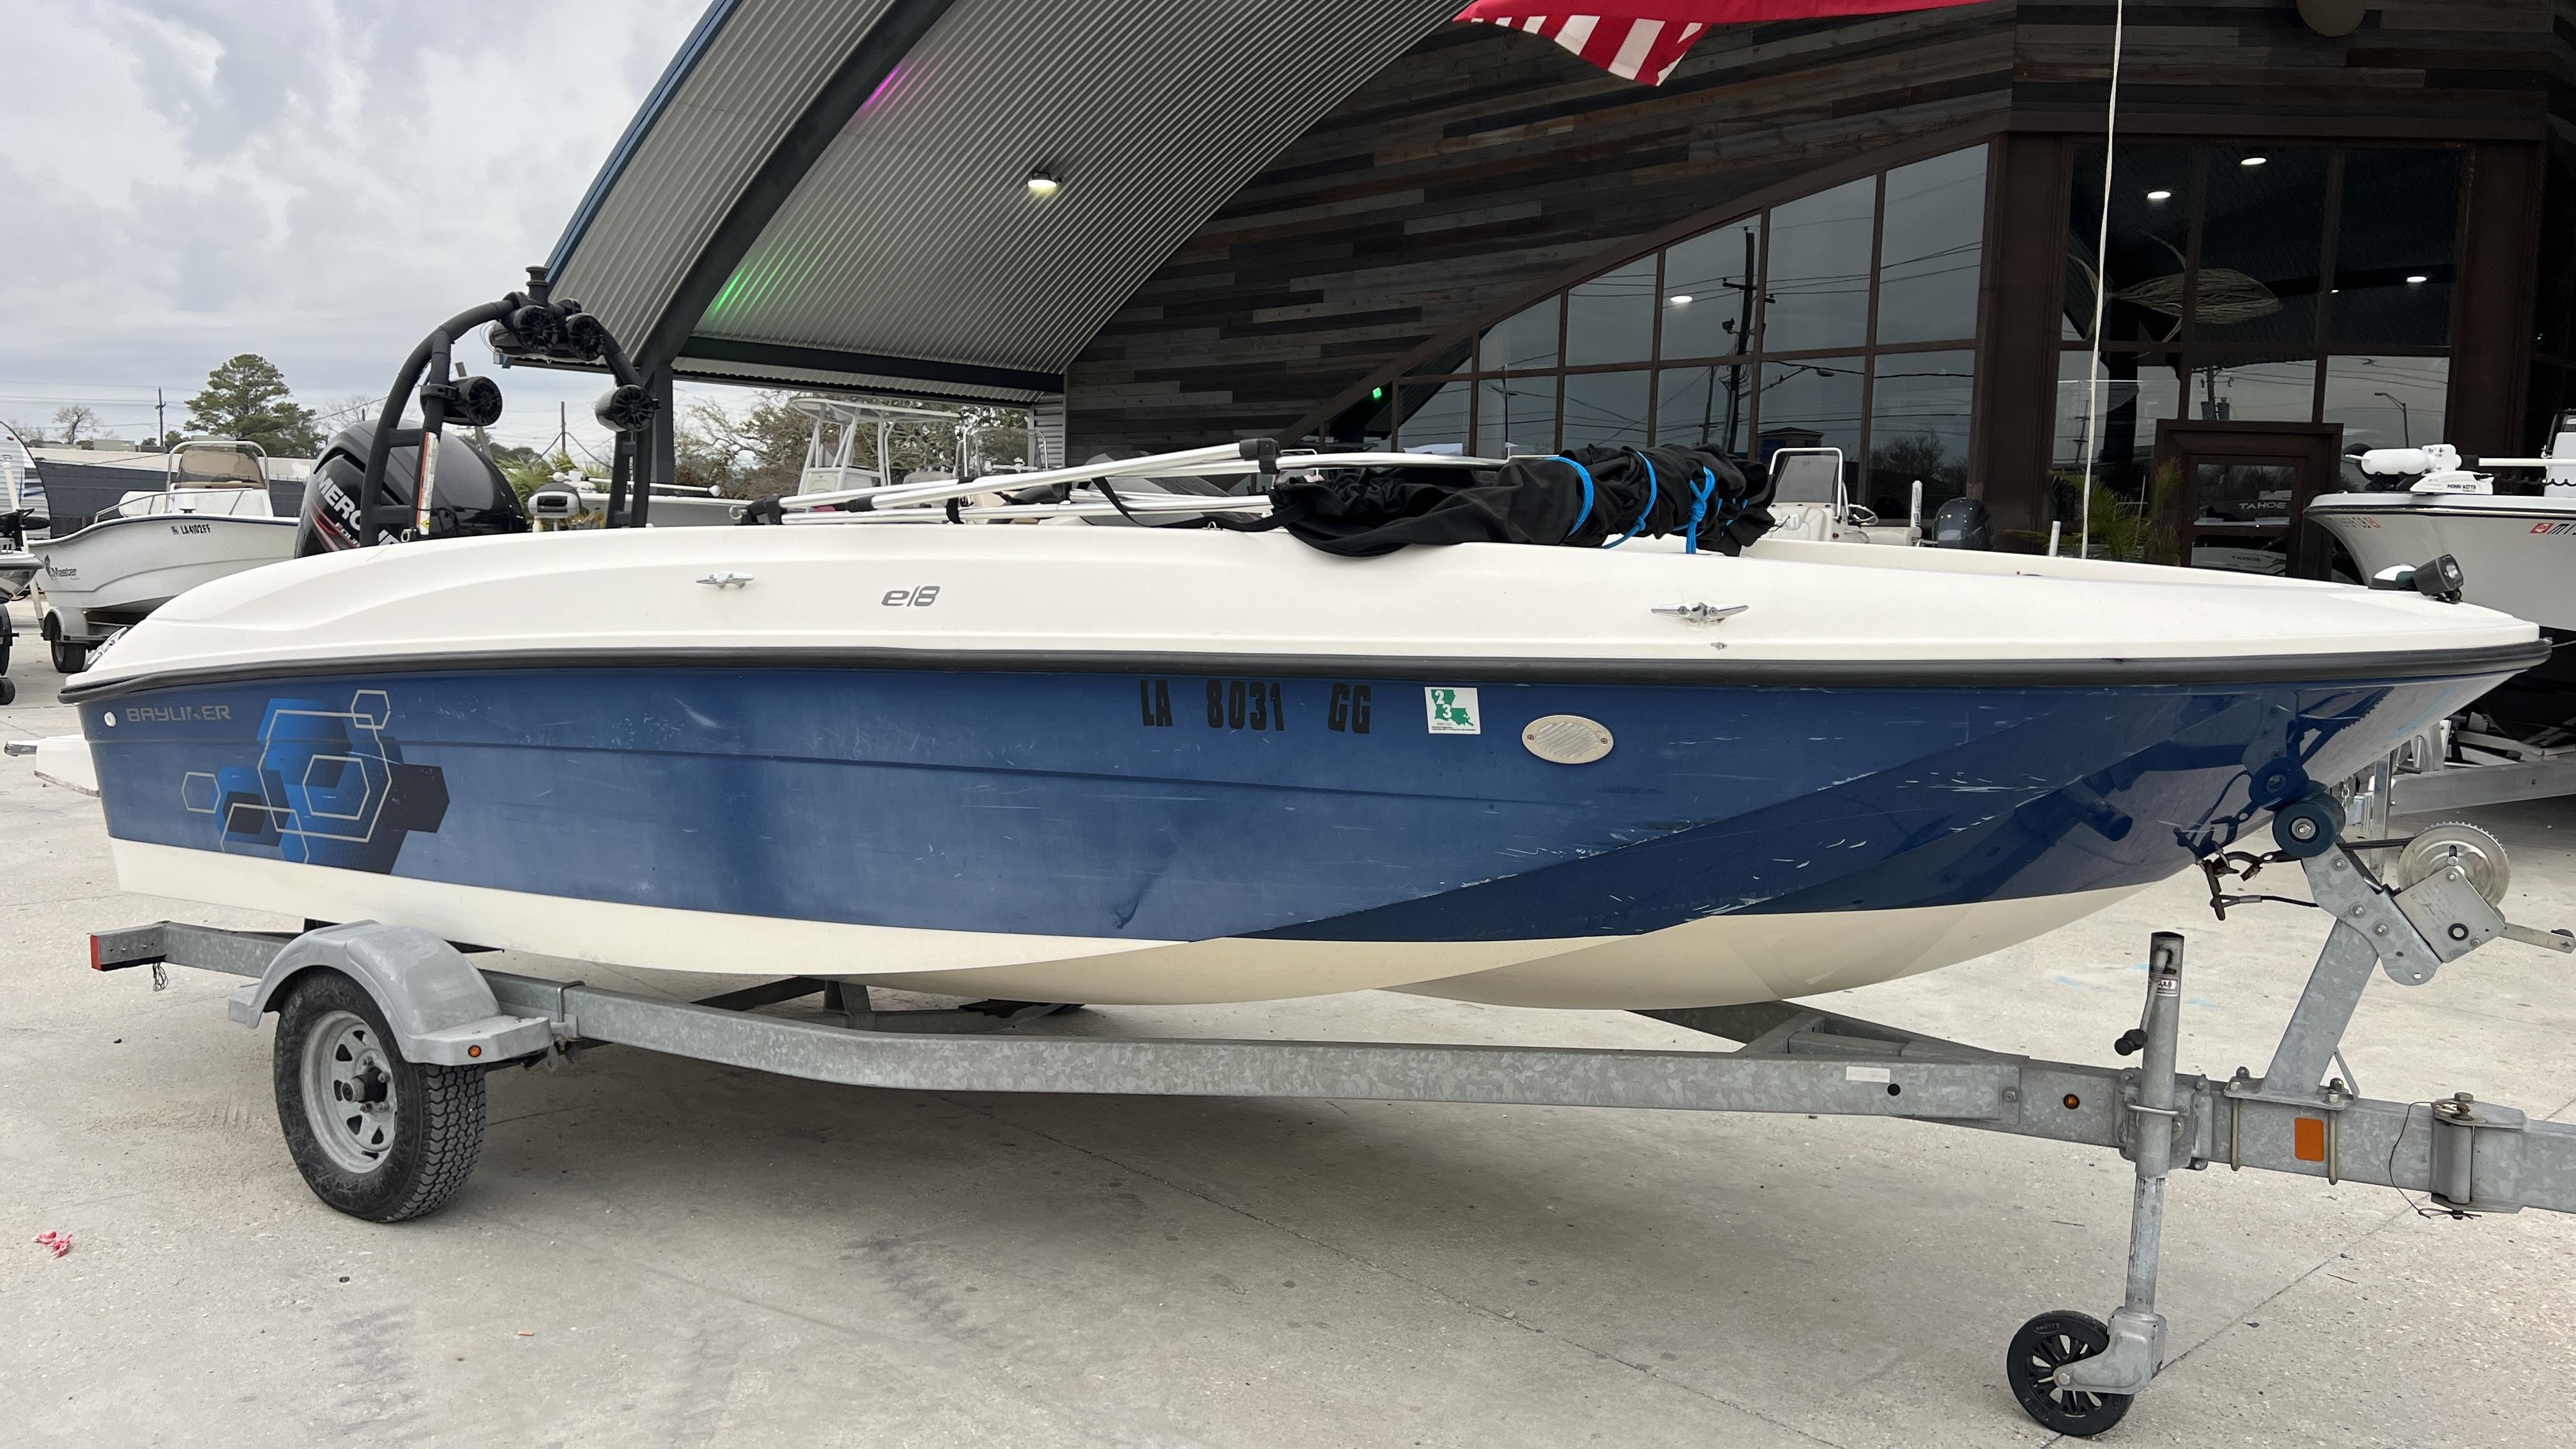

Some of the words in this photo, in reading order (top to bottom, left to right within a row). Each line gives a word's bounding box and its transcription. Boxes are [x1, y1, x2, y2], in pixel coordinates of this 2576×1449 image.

[2239, 502, 2287, 510] TAHOE
[126, 705, 232, 722] BAYLINER
[1140, 679, 1173, 726] LA
[1206, 680, 1285, 731] 8031
[1328, 683, 1371, 734] GG
